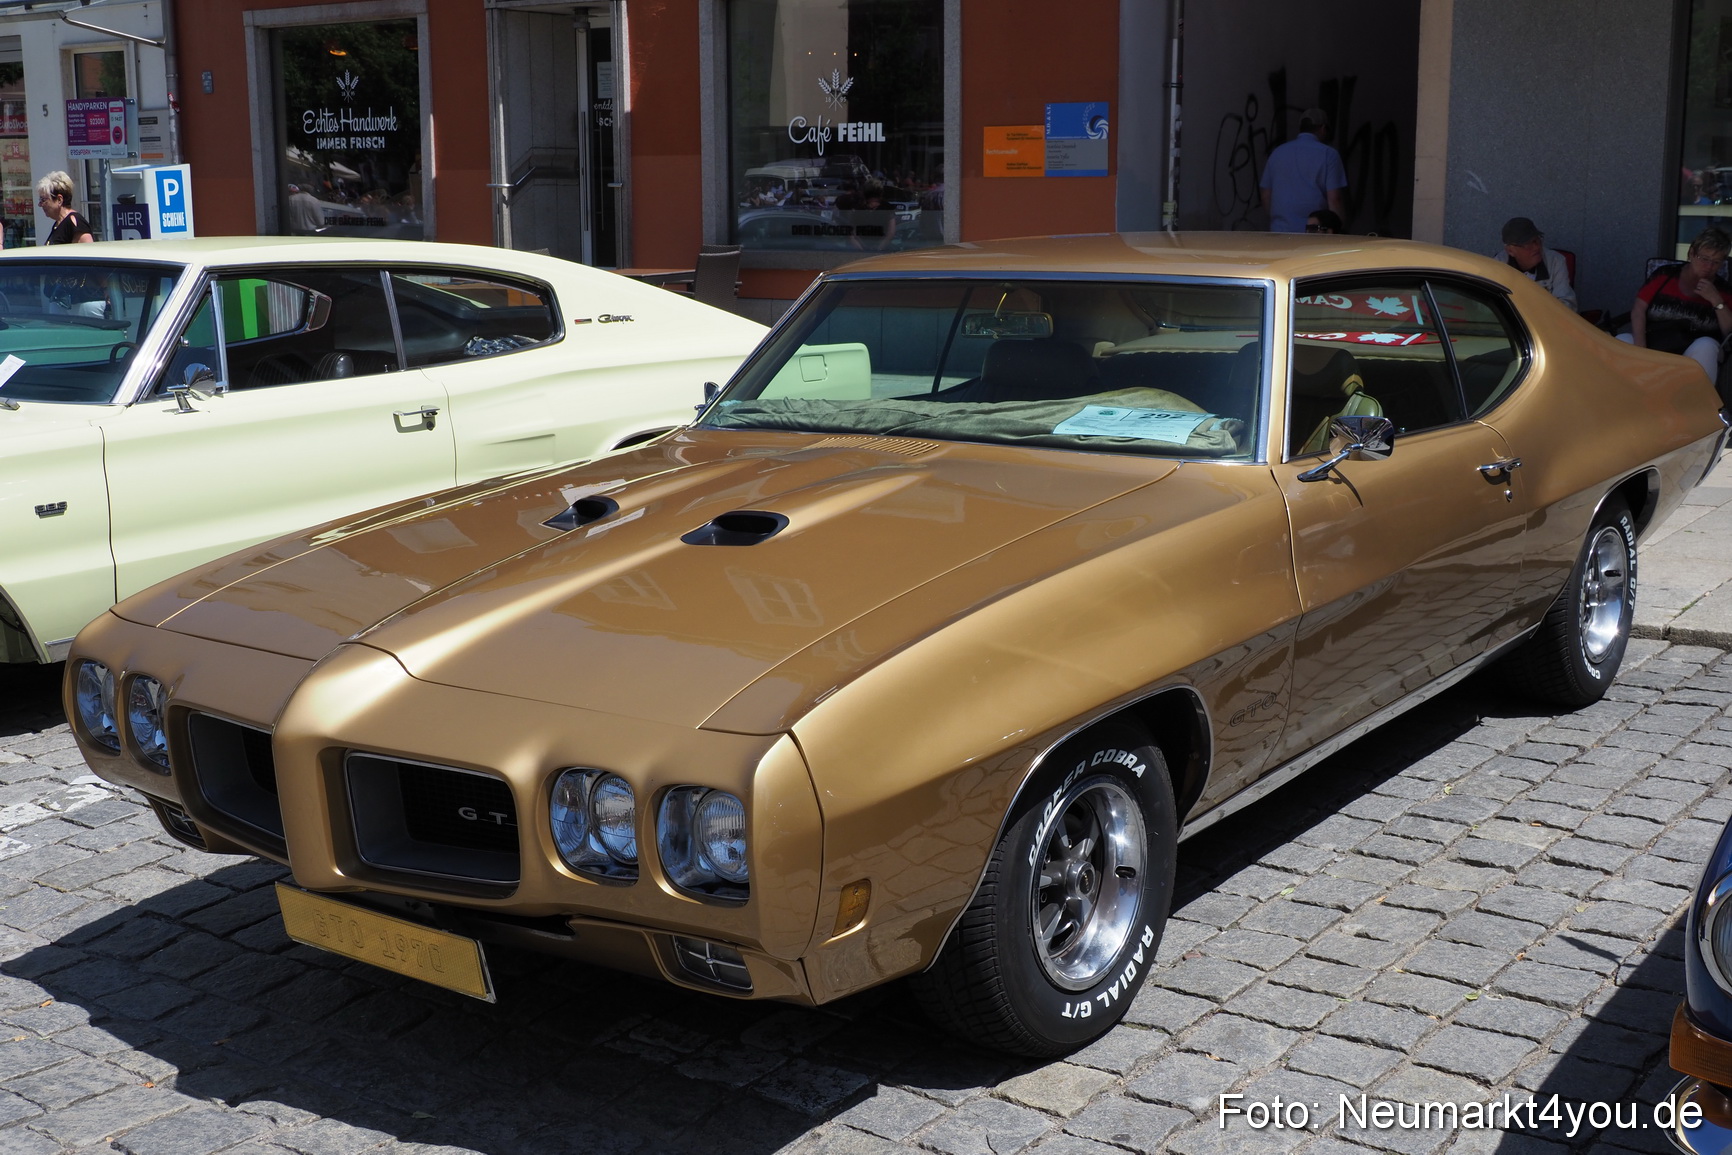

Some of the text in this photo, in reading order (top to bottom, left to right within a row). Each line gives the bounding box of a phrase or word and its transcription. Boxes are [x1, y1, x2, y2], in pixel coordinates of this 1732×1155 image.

[42, 104, 49, 117] 5
[67, 101, 107, 111] HANDYPARKEN
[302, 106, 398, 134] Echtes Handwerk
[316, 136, 385, 149] IMMER FRISCH
[788, 115, 832, 156] Café
[163, 178, 180, 206] P
[117, 212, 143, 226] HIER
[1620, 515, 1637, 572] RADIAL
[1230, 692, 1278, 727] GTO
[1090, 749, 1146, 779] COBRA
[313, 909, 445, 974] GTO 1970
[1061, 925, 1154, 1019] RADIAL G/T
